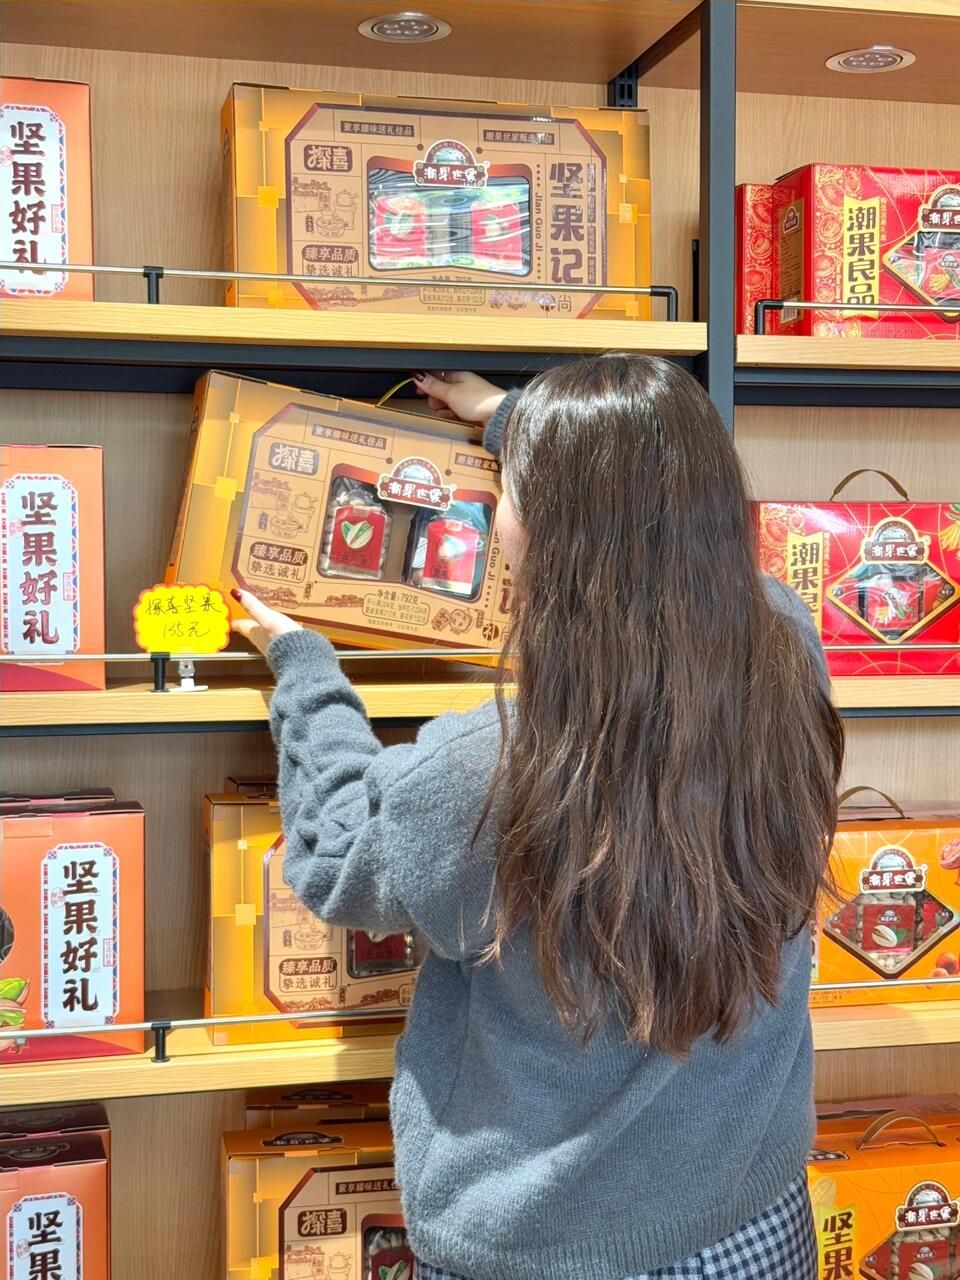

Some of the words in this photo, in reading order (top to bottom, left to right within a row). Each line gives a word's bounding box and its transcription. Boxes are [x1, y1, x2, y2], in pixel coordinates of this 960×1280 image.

[9, 121, 47, 275] 坚果好礼
[535, 192, 544, 215] Jian
[535, 219, 544, 240] Guo
[549, 162, 585, 284] 坚果记
[304, 248, 357, 262] 臻享品质
[252, 544, 306, 565] 臻享品质
[19, 490, 60, 645] 坚果好礼
[60, 859, 100, 1013] 坚果好礼
[282, 959, 336, 974] 臻享品质
[282, 975, 335, 990] 挚选诚礼
